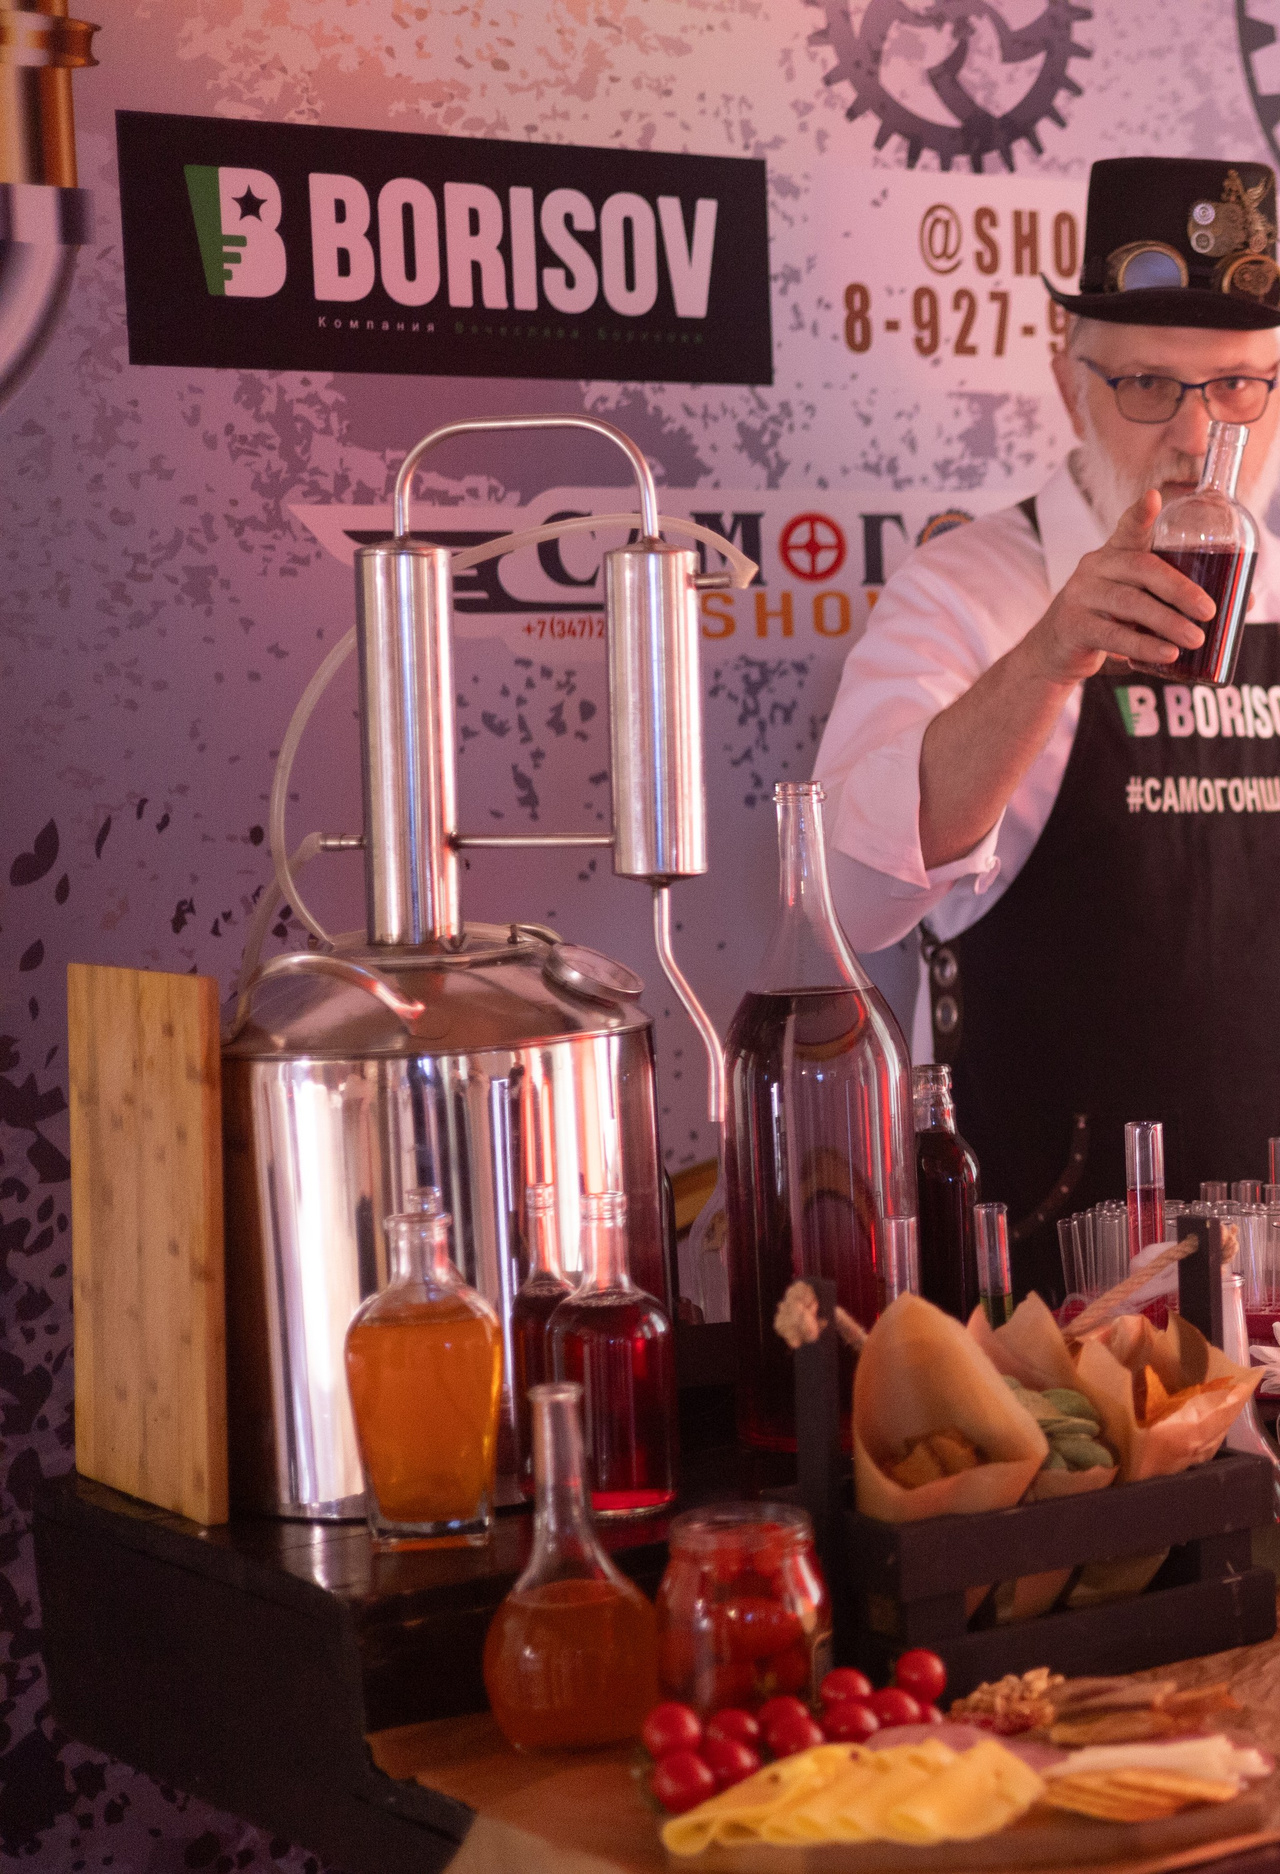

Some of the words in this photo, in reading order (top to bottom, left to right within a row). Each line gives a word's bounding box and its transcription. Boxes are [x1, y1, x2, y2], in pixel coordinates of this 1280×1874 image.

[308, 172, 718, 319] BORISOV
[919, 203, 1078, 278] @SHO
[317, 315, 436, 334] Компания
[701, 591, 879, 639] SHO
